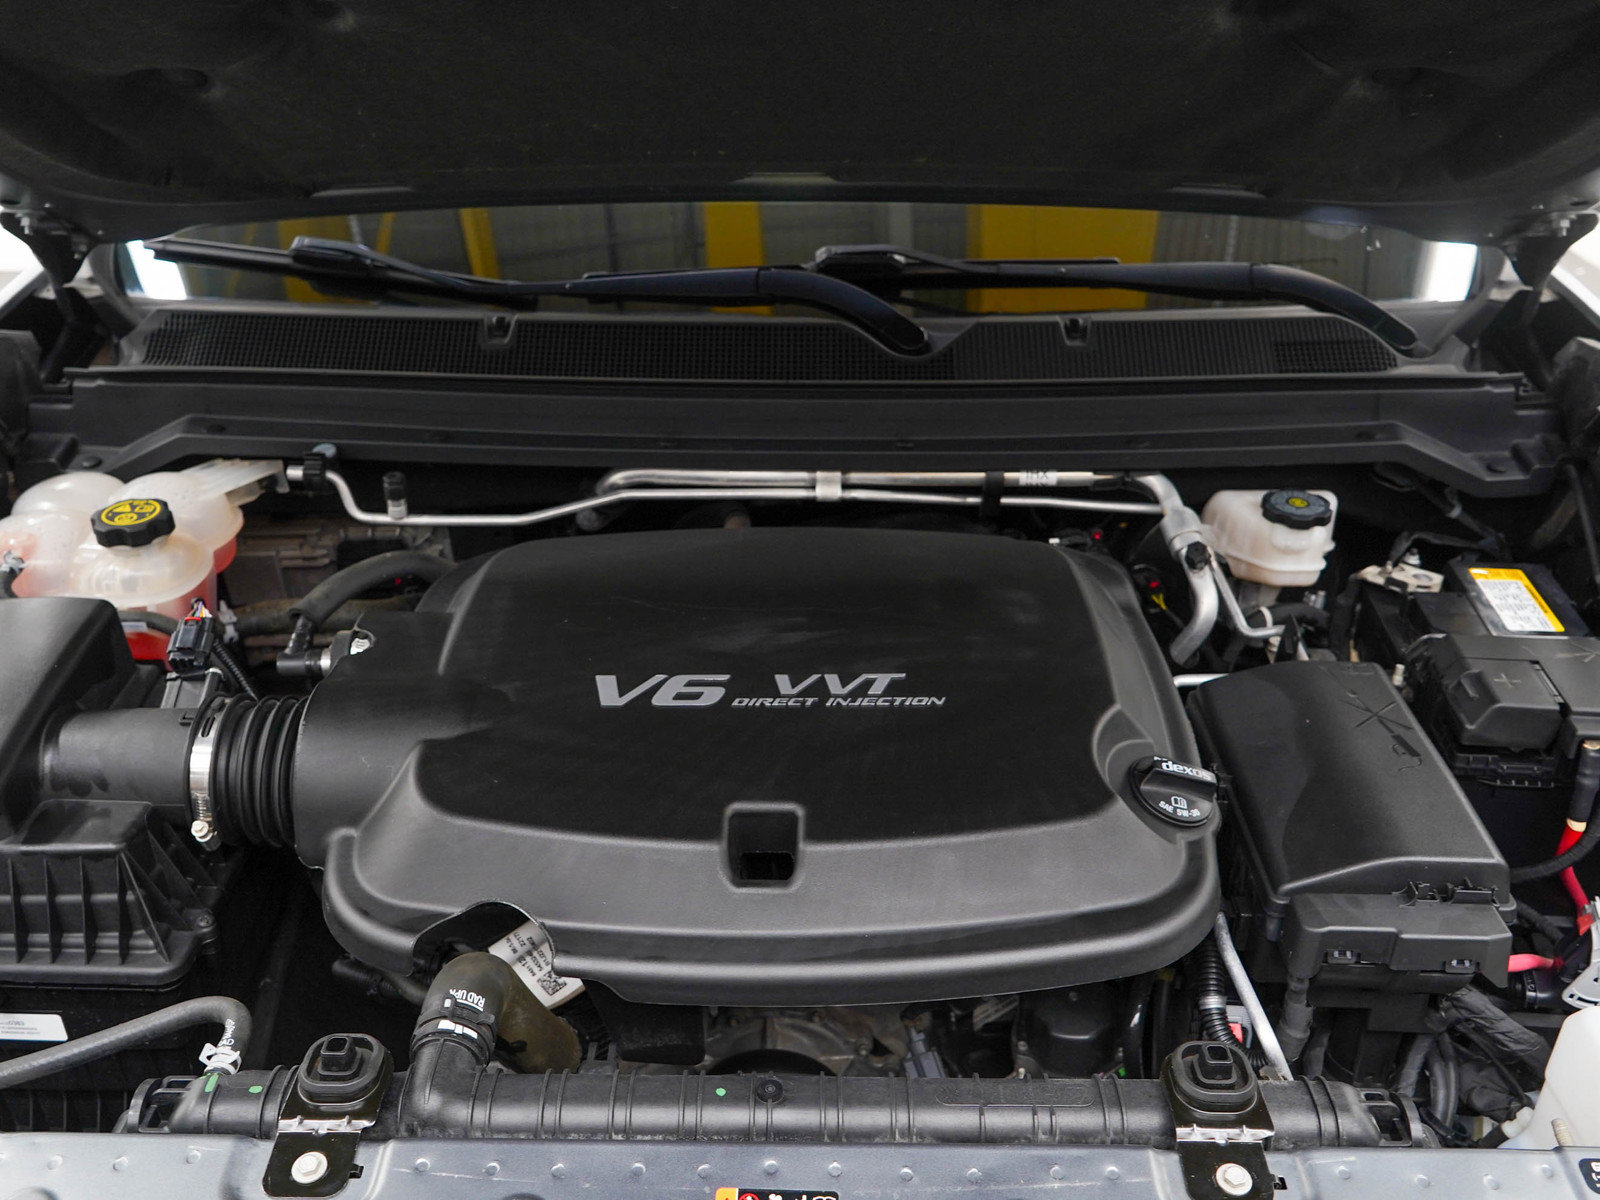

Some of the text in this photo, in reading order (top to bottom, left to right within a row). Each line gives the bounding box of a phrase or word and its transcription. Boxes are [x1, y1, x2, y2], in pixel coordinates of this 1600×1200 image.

[595, 673, 906, 706] V6 VVT
[732, 697, 946, 707] DIRECT INJECTION
[1162, 761, 1211, 780] dexos
[1159, 801, 1174, 813] SAE
[467, 992, 486, 1007] RAD
